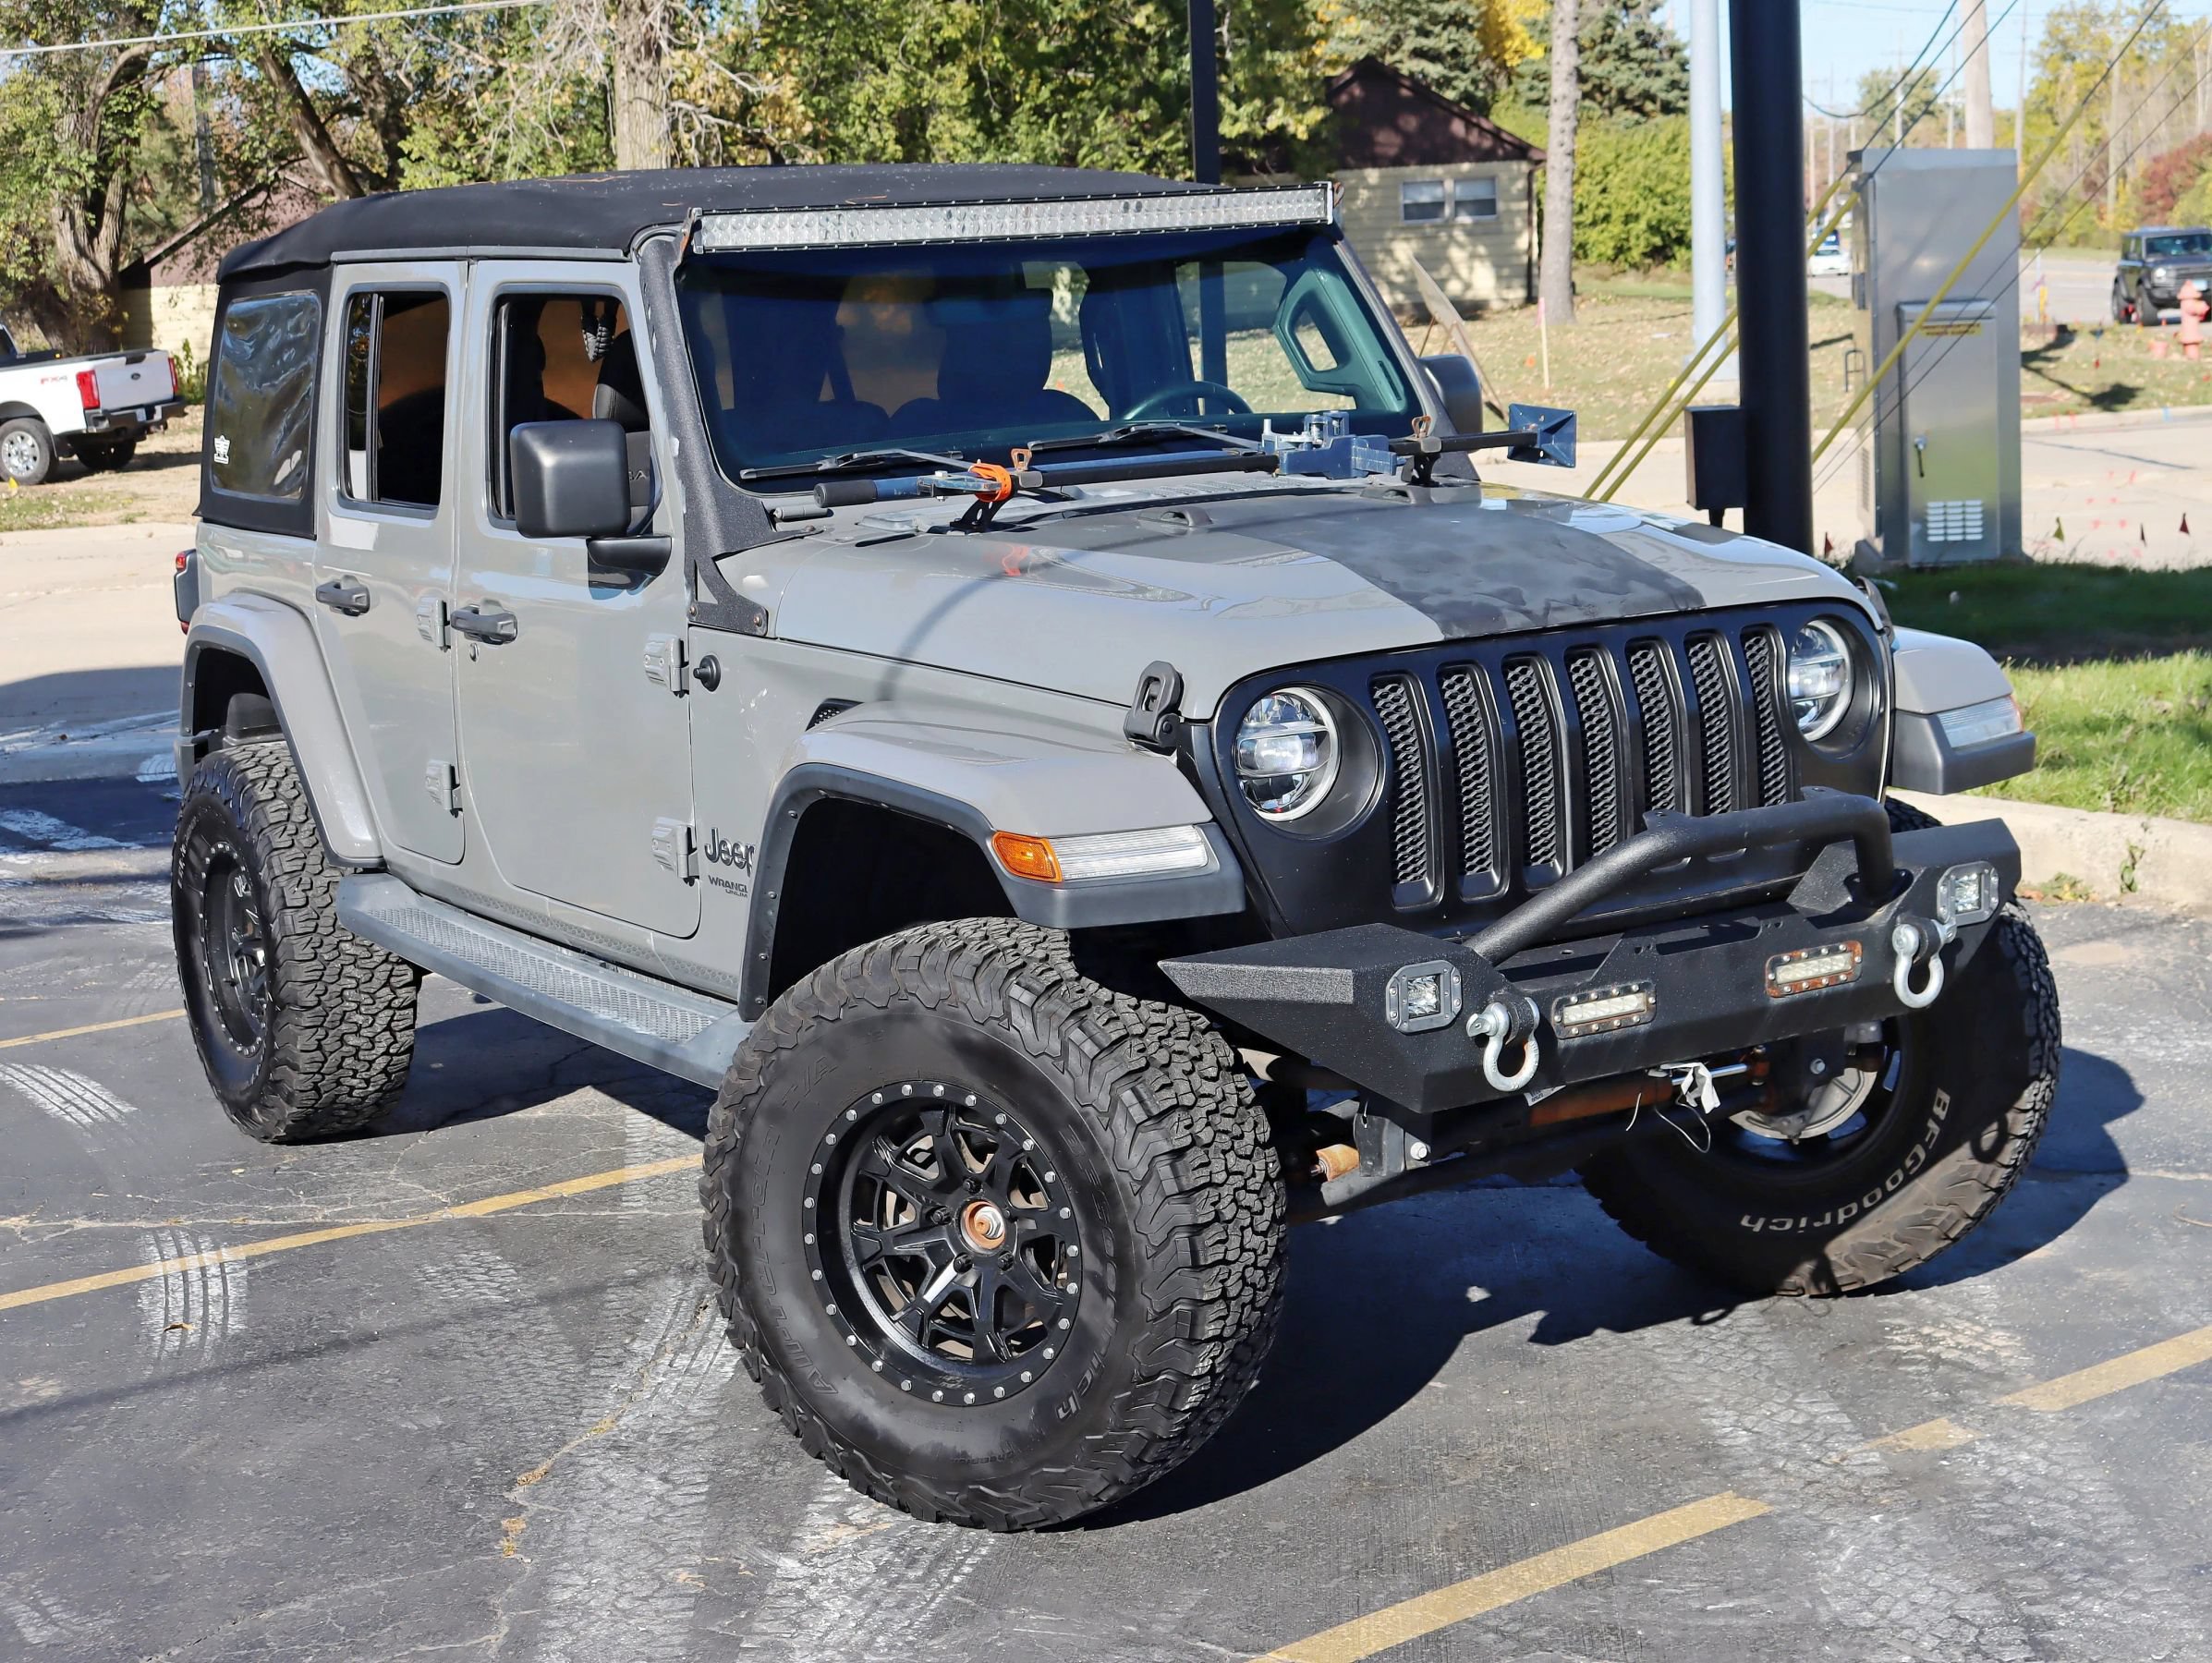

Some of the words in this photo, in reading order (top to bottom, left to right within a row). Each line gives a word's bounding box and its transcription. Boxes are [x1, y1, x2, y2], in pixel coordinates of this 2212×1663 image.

[708, 874, 747, 893] WRANGL
[725, 888, 747, 899] UNLIM
[1740, 1086, 1952, 1234] BFGoodrich
